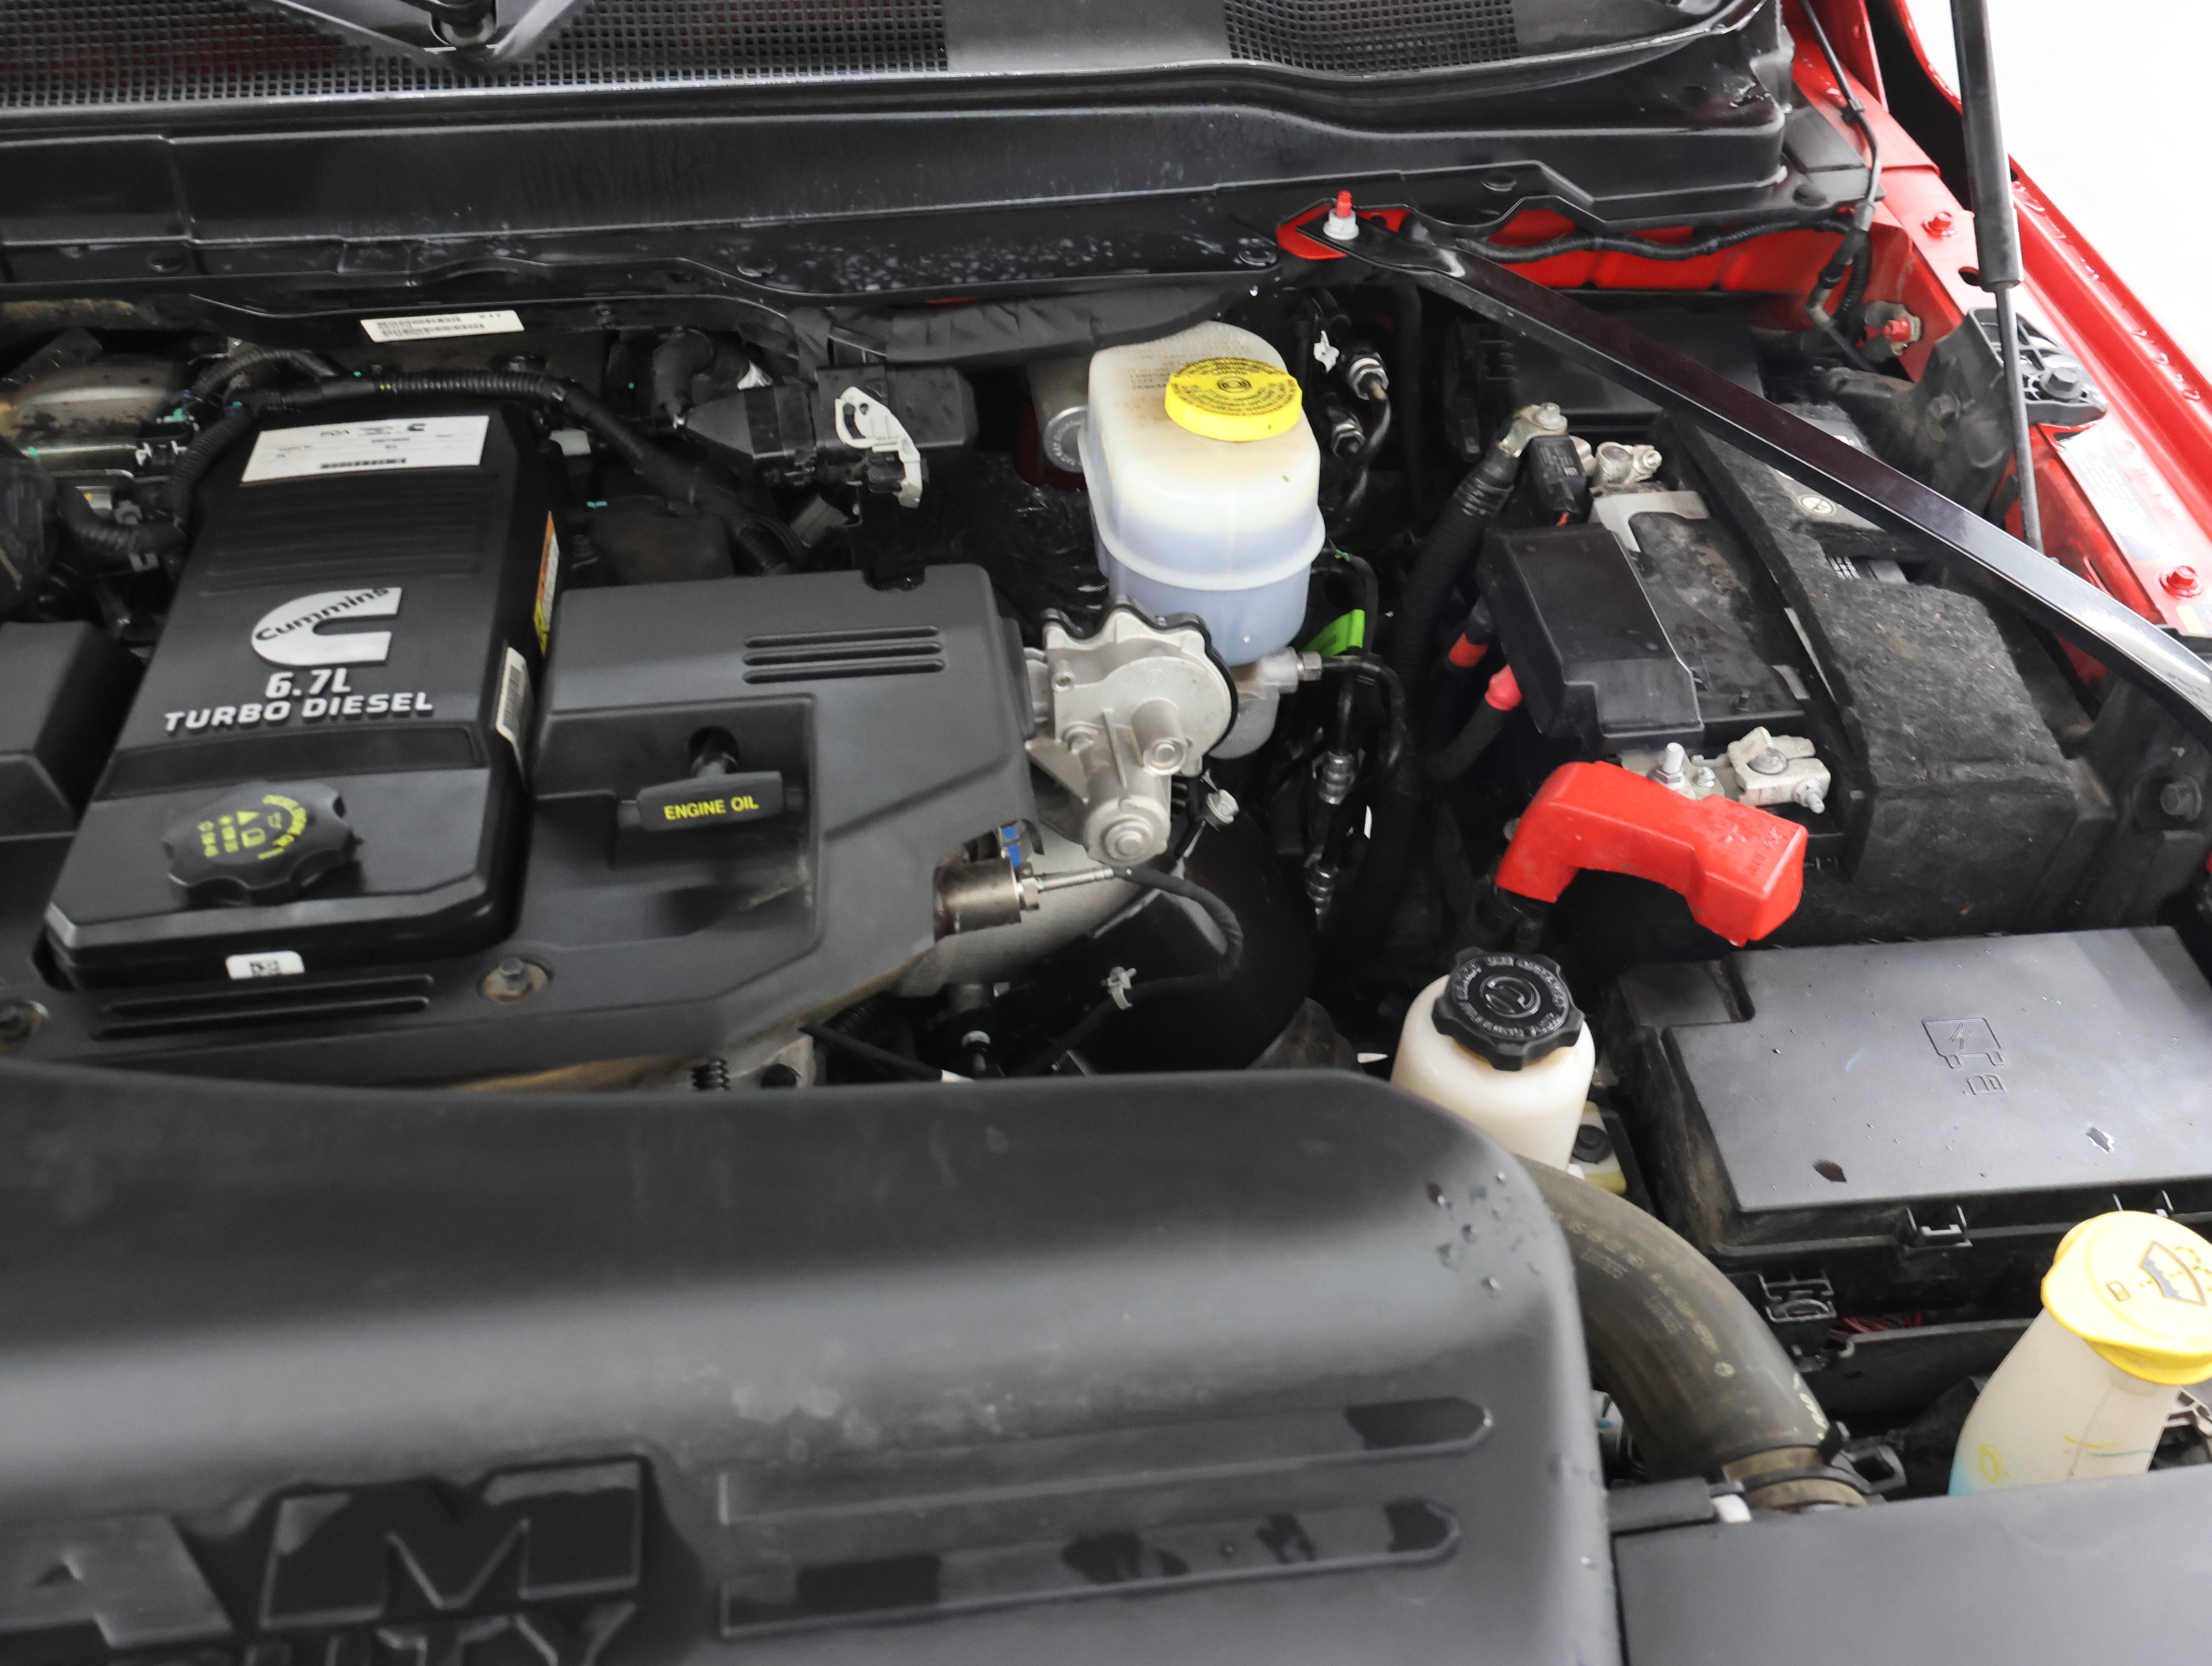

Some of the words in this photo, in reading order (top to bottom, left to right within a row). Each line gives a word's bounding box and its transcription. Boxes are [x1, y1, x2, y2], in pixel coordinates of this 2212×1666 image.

[256, 587, 389, 641] Cummins
[265, 668, 351, 699] 6.7L
[165, 701, 291, 732] TURBO
[301, 692, 434, 718] DIESEL
[663, 799, 726, 821] ENGINE
[730, 795, 760, 812] OIL
